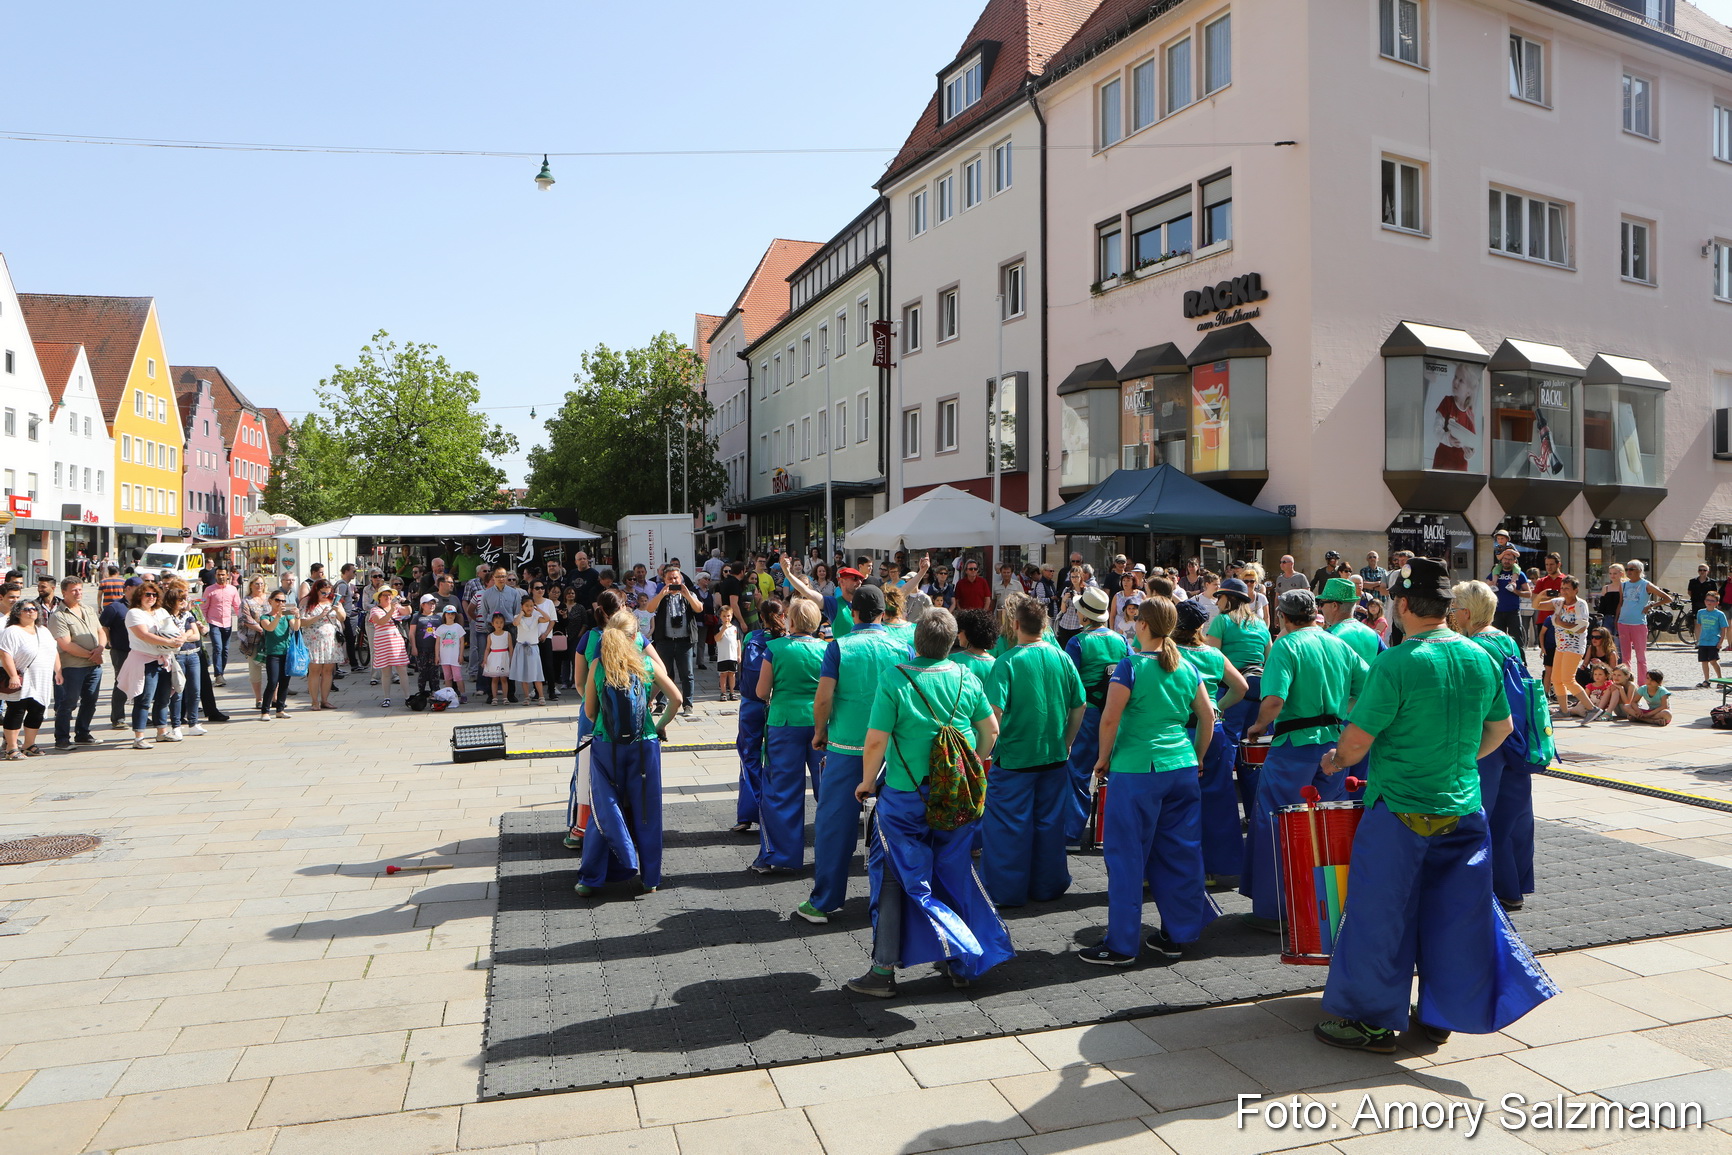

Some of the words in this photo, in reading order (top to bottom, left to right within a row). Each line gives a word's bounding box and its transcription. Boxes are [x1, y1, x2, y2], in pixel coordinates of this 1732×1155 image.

[1184, 272, 1269, 319] RACKL
[1196, 321, 1214, 332] am
[1214, 306, 1261, 327] Rathaus
[876, 330, 887, 364] Achatz
[1124, 392, 1146, 410] RACKL
[1540, 388, 1563, 406] RACKL
[244, 525, 276, 535] POPCORN
[1391, 527, 1417, 535] Willkommen
[1423, 524, 1445, 540] RACKL
[1522, 526, 1541, 541] RACKL
[1611, 530, 1628, 543] RACKL
[1722, 534, 1732, 547] RAC
